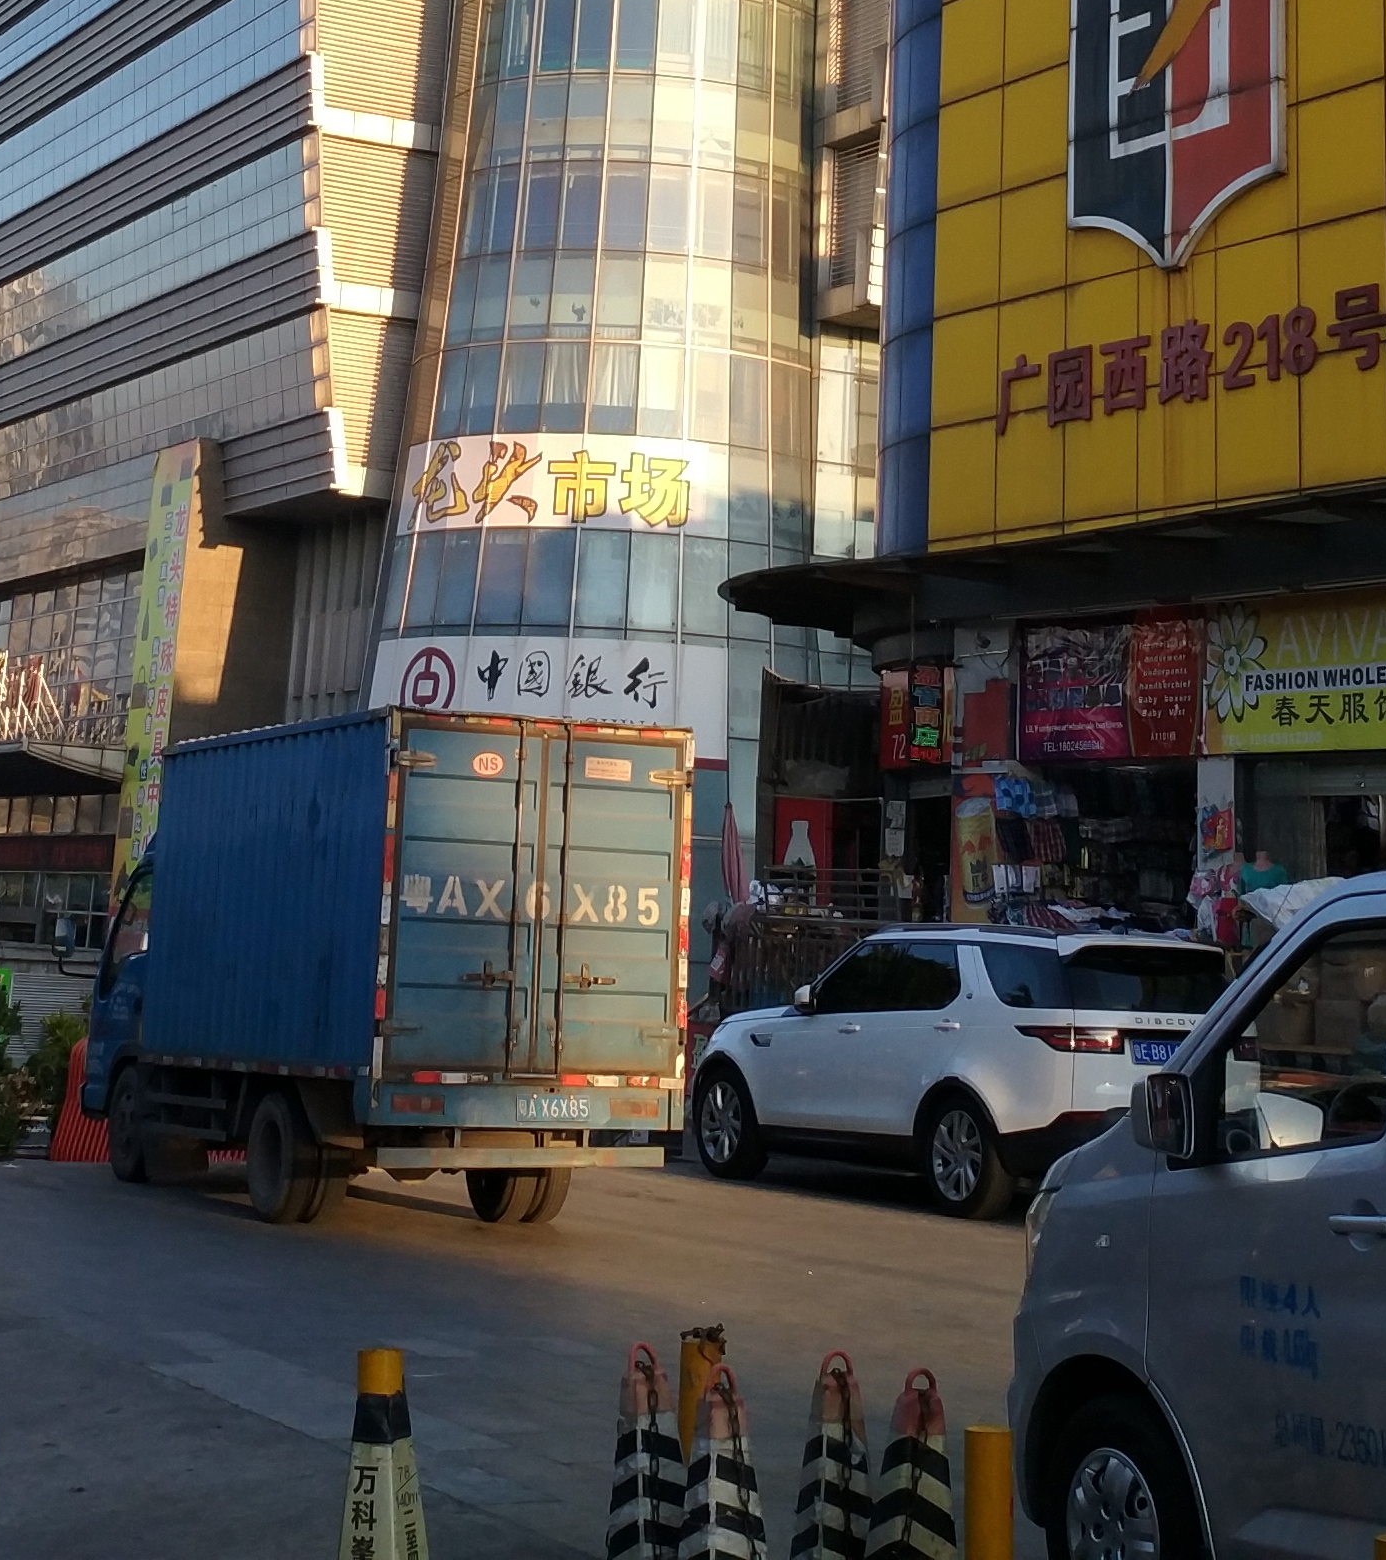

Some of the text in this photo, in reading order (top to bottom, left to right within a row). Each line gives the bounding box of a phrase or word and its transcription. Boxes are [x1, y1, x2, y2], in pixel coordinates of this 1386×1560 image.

[1244, 670, 1319, 692] FASHION
[478, 757, 499, 772] NS
[1135, 1017, 1197, 1026] DISCOV
